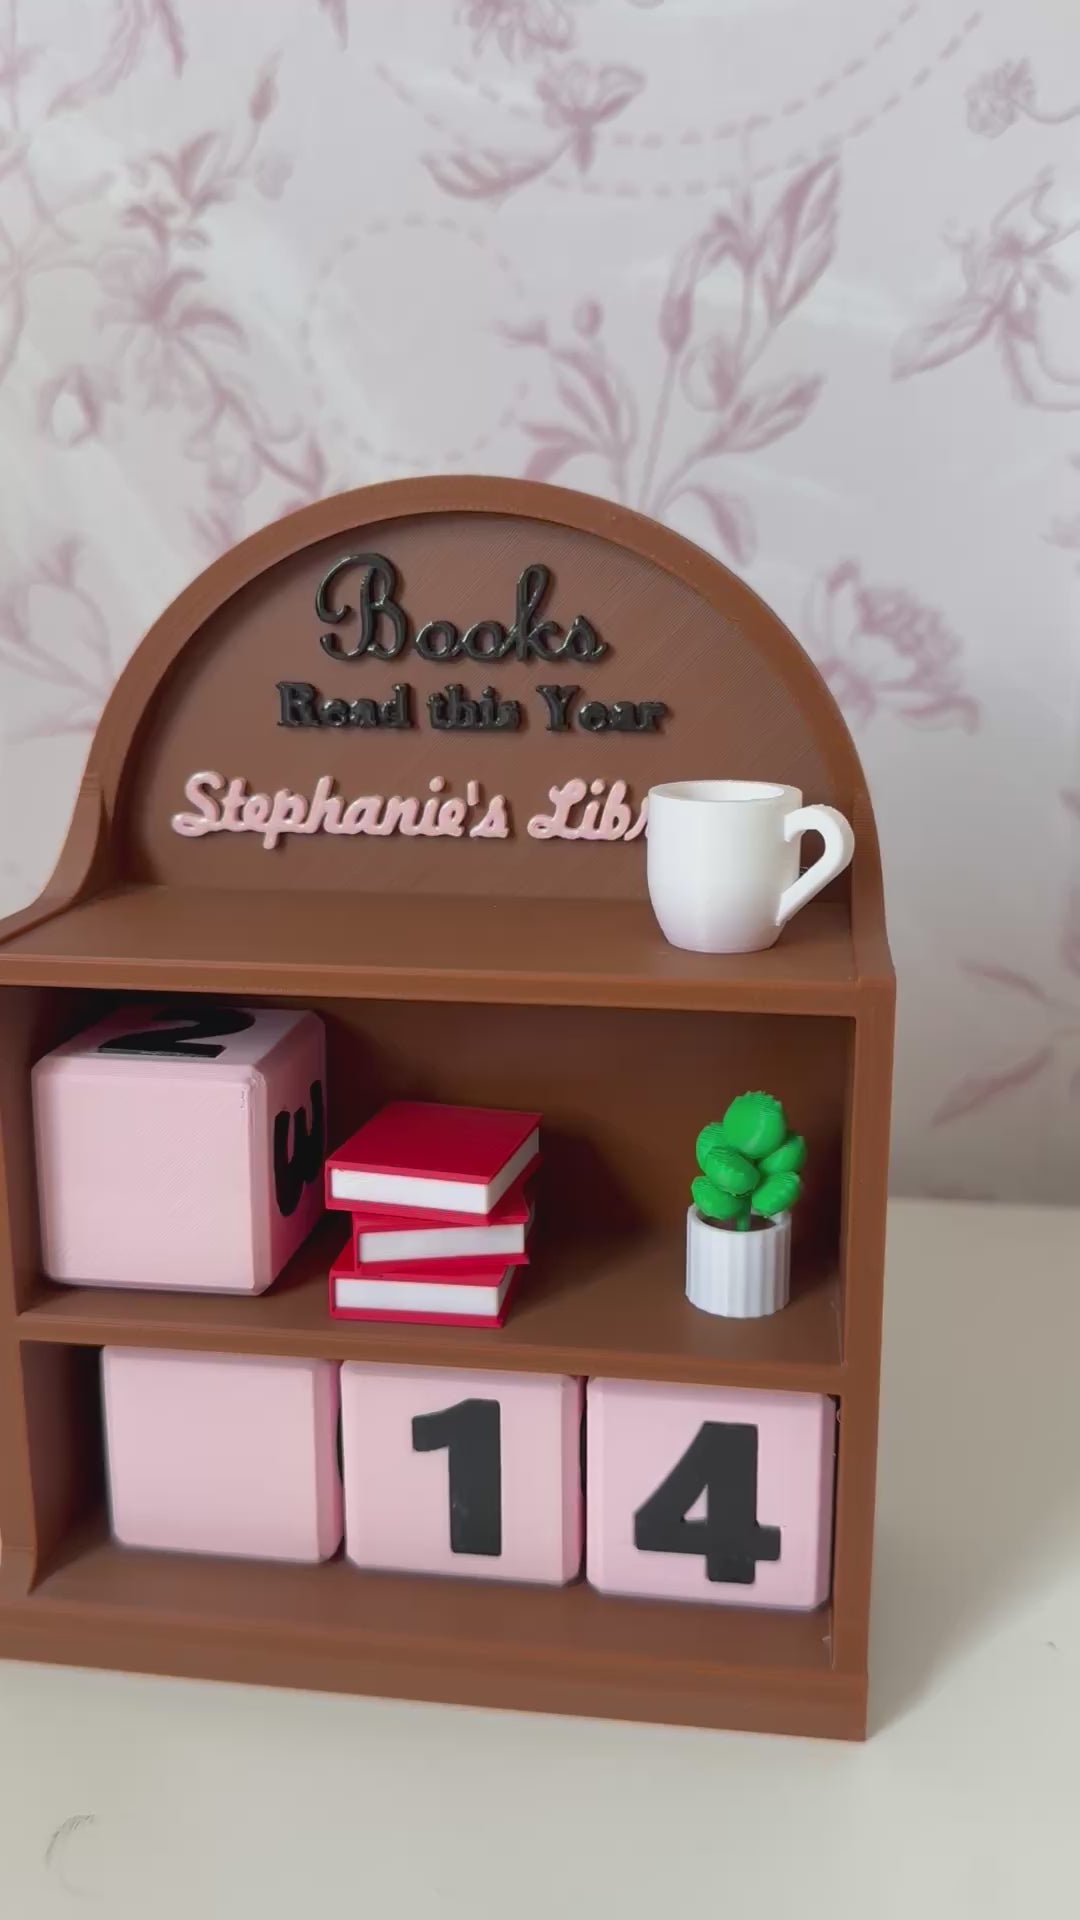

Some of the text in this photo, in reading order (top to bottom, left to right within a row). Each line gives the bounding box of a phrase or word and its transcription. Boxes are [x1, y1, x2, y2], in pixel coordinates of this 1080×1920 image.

[314, 552, 609, 662] Books
[276, 681, 668, 734] Read this Year
[171, 770, 509, 850] Stephanie's
[98, 1007, 256, 1058] 2
[411, 1398, 782, 1584] 1 4
